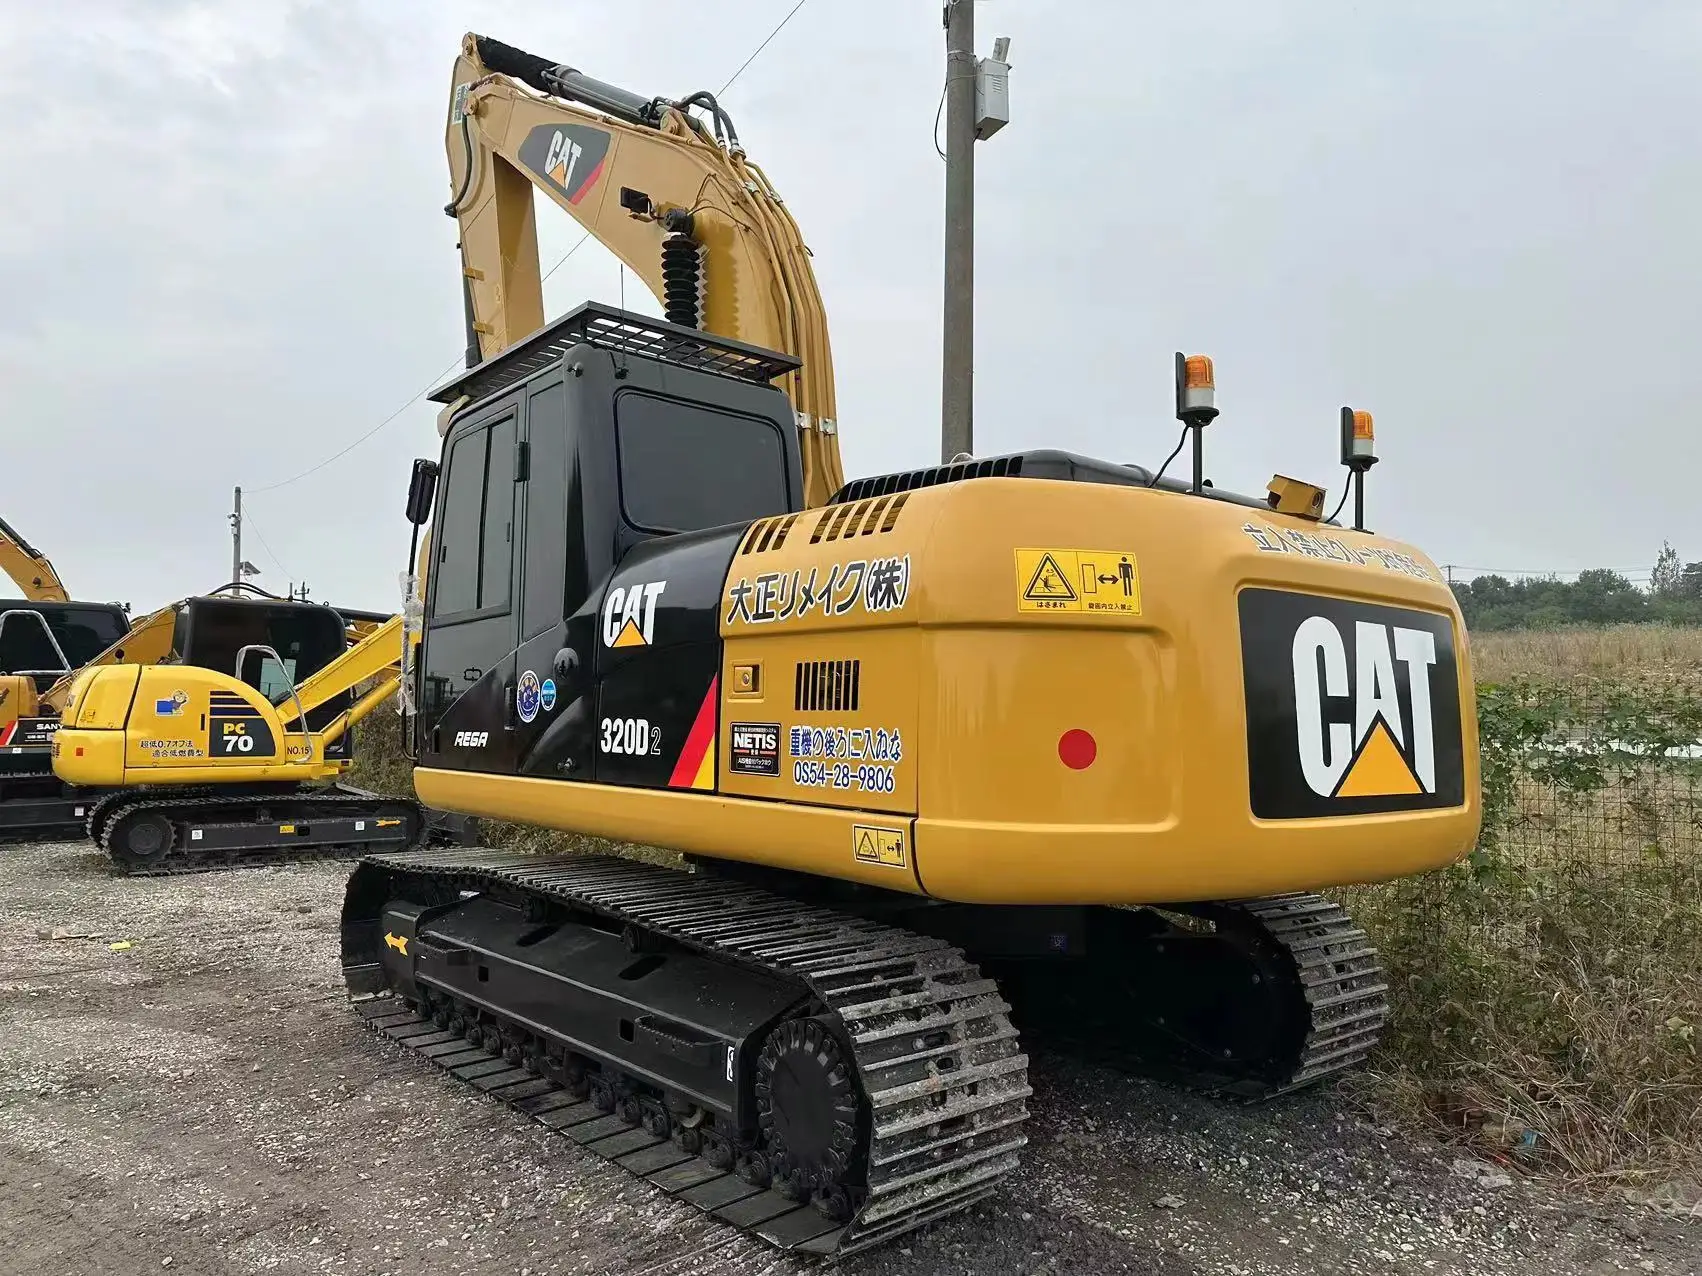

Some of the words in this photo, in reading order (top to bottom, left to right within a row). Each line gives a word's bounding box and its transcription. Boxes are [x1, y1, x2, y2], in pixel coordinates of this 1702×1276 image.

[544, 130, 583, 190] CAT
[603, 581, 667, 648] CAT
[727, 553, 910, 625] 大正リメイク(株)
[223, 722, 246, 735] PC
[1292, 616, 1437, 798] CAT
[222, 735, 254, 752] 70
[733, 733, 777, 750] NETIS
